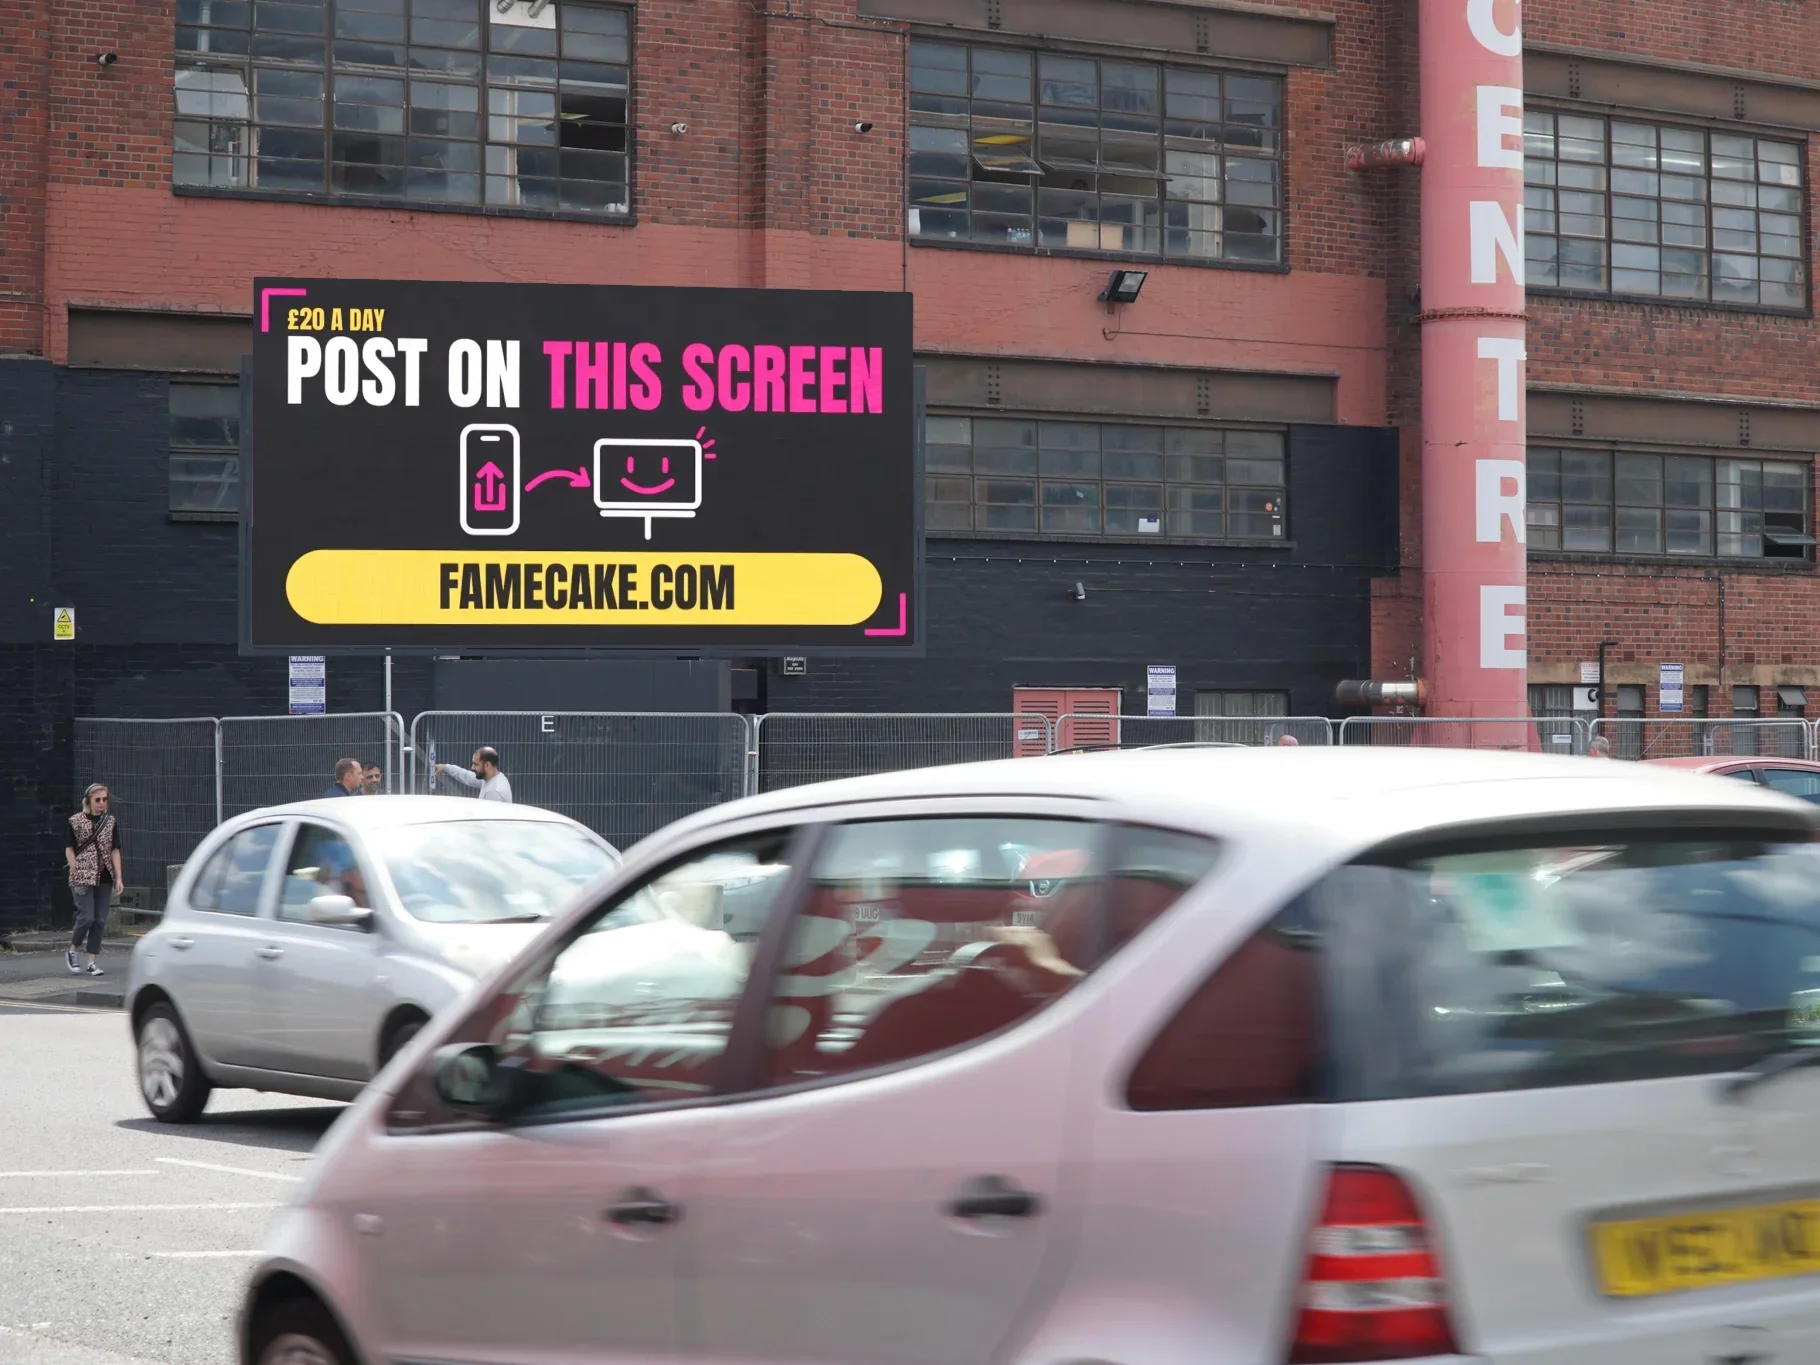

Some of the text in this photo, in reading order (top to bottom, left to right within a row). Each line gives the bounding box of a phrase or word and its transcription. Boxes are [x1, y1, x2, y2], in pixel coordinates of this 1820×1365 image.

[288, 308, 385, 332] £20 A DAY
[1467, 0, 1526, 668] CENTRE
[288, 336, 883, 414] POST ON THIS SCREEN
[440, 563, 735, 611] FAMECAKE.COM
[542, 716, 555, 732] E
